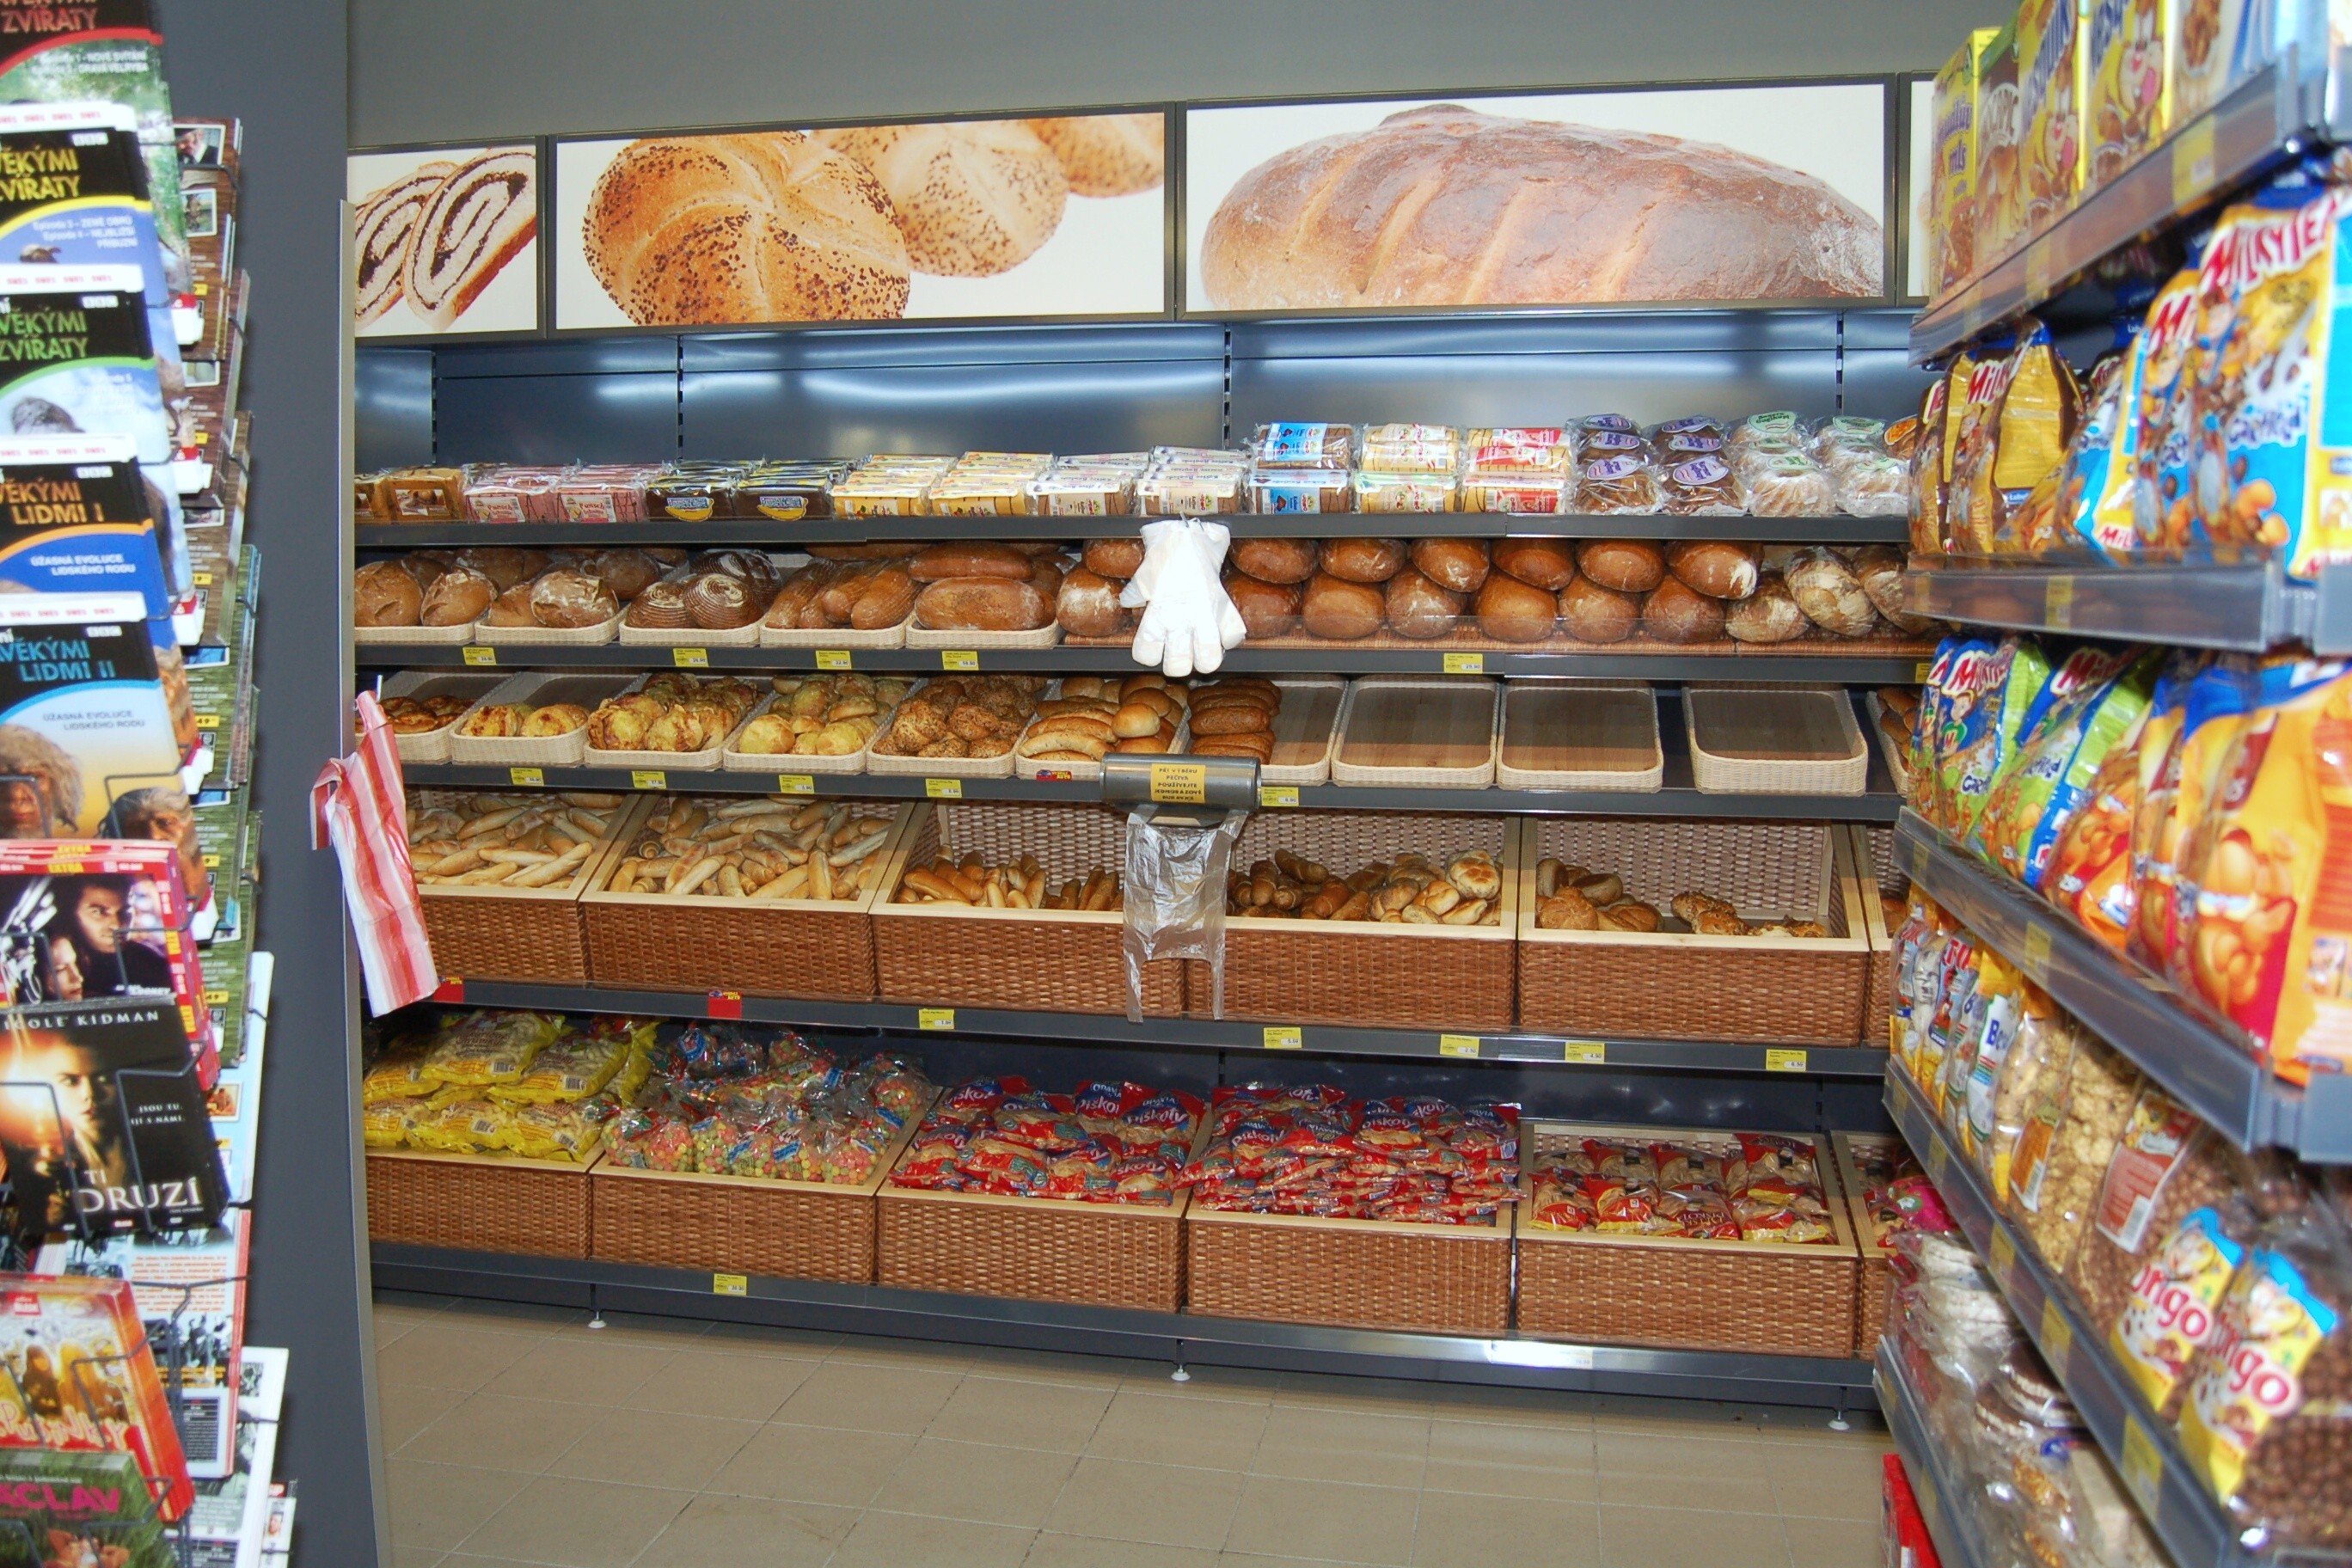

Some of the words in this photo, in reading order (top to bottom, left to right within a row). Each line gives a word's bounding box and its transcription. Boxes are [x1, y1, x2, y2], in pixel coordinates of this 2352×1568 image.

[11, 503, 88, 525] LIDMI
[20, 659, 92, 683] LIDMI
[77, 1009, 160, 1026] KIDMAN
[84, 1168, 107, 1185] TI
[78, 1176, 203, 1214] DRUZÍ
